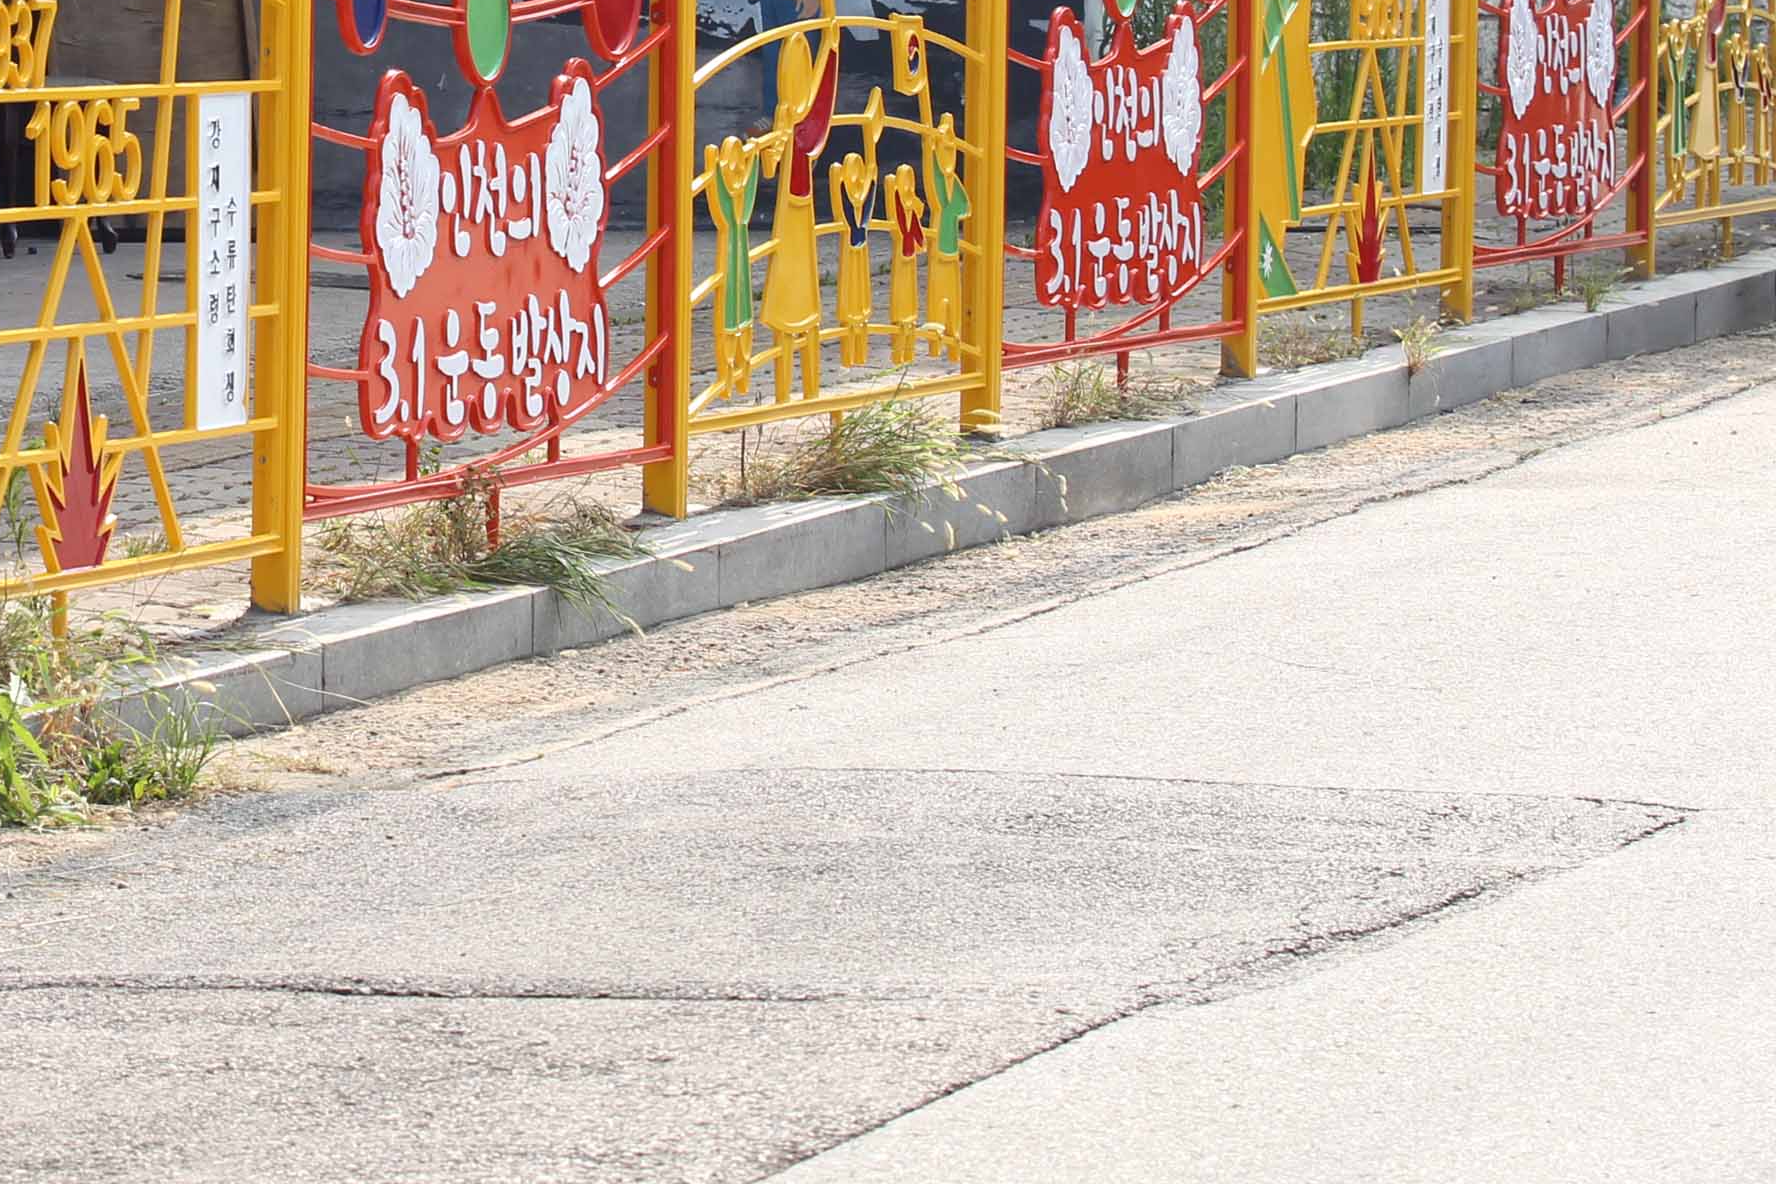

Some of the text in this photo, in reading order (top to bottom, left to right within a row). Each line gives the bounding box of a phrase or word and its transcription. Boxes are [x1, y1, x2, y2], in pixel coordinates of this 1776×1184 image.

[1537, 12, 1585, 96] 인천의
[25, 96, 142, 208] 1965
[1093, 63, 1161, 162] 인천의
[441, 139, 542, 258] 인천의
